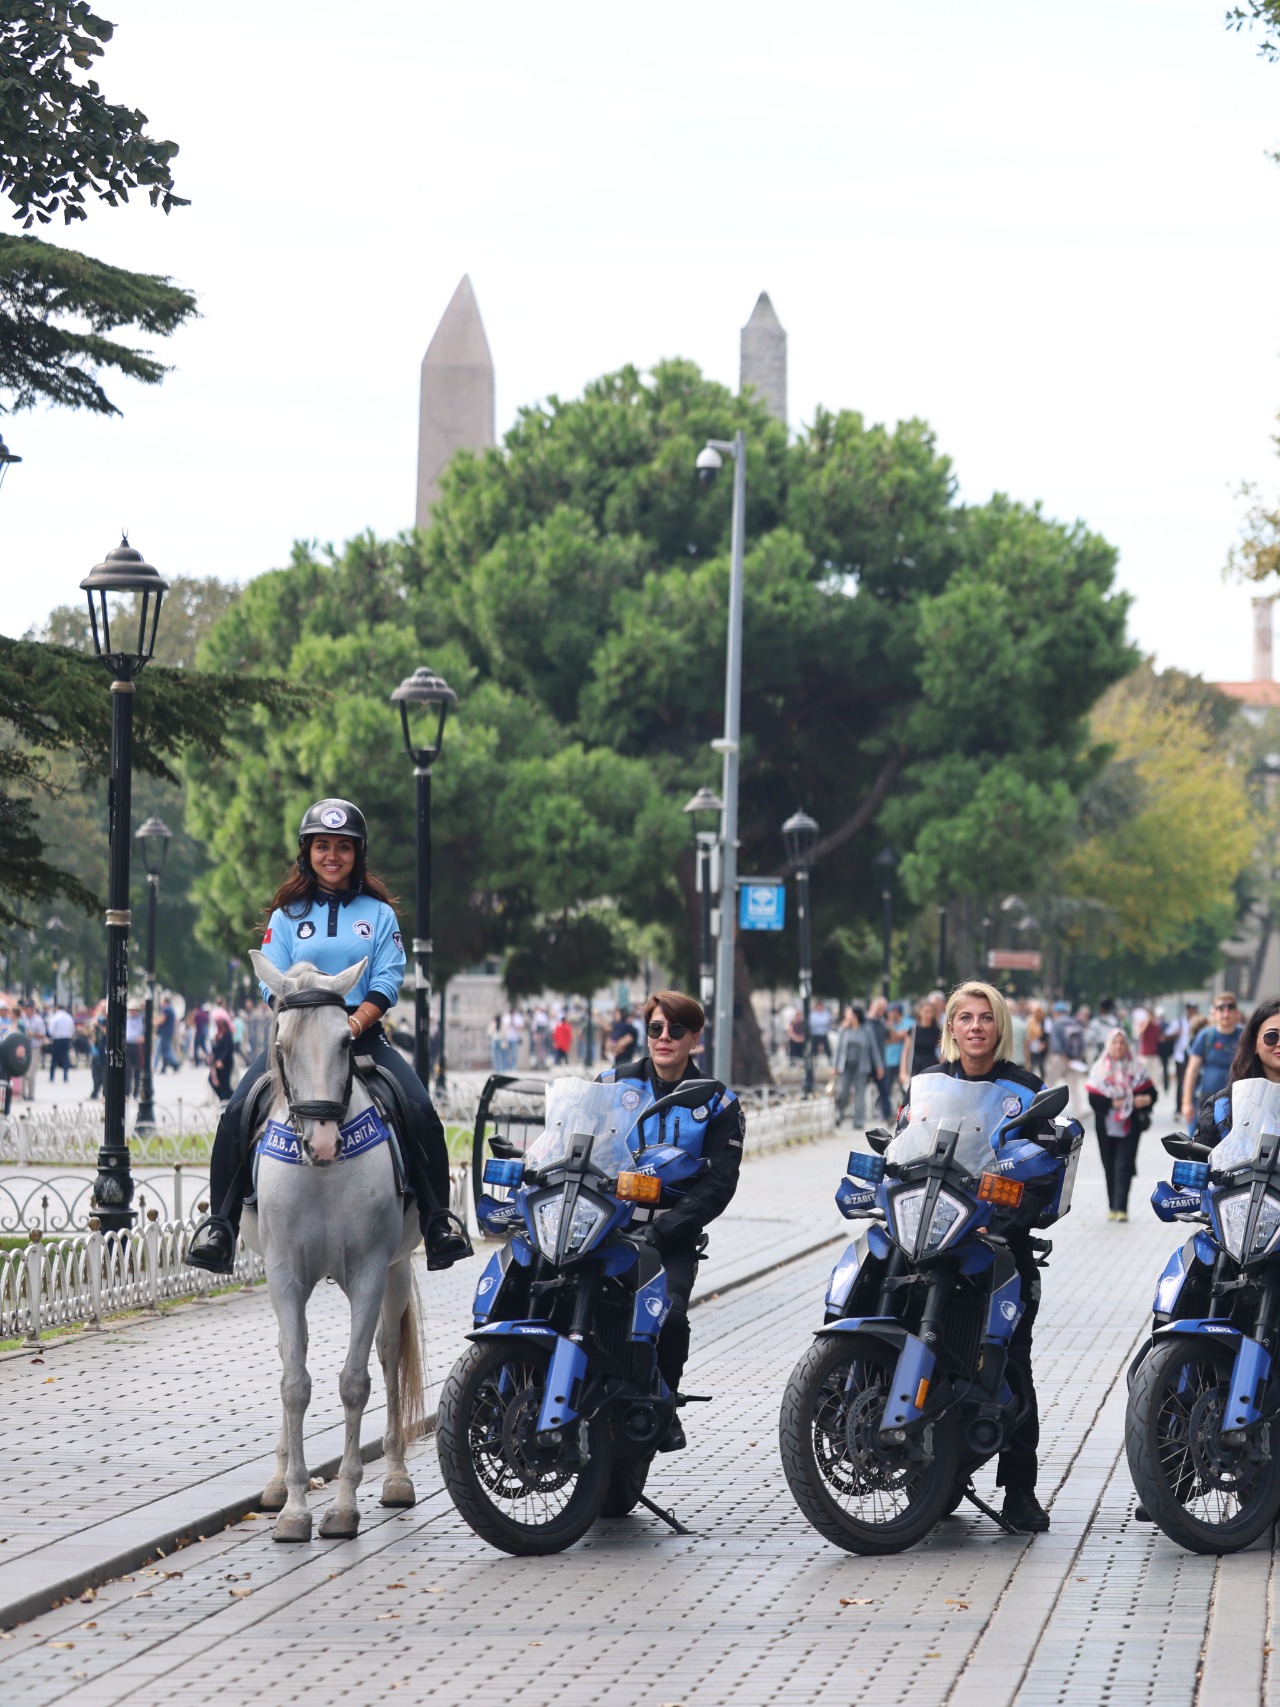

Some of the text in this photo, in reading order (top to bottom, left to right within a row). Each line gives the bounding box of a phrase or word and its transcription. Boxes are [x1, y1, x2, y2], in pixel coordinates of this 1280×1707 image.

[341, 1122, 376, 1150] ABITA
[851, 1193, 876, 1205] ZABIT
[1170, 1198, 1201, 1209] ZABITA
